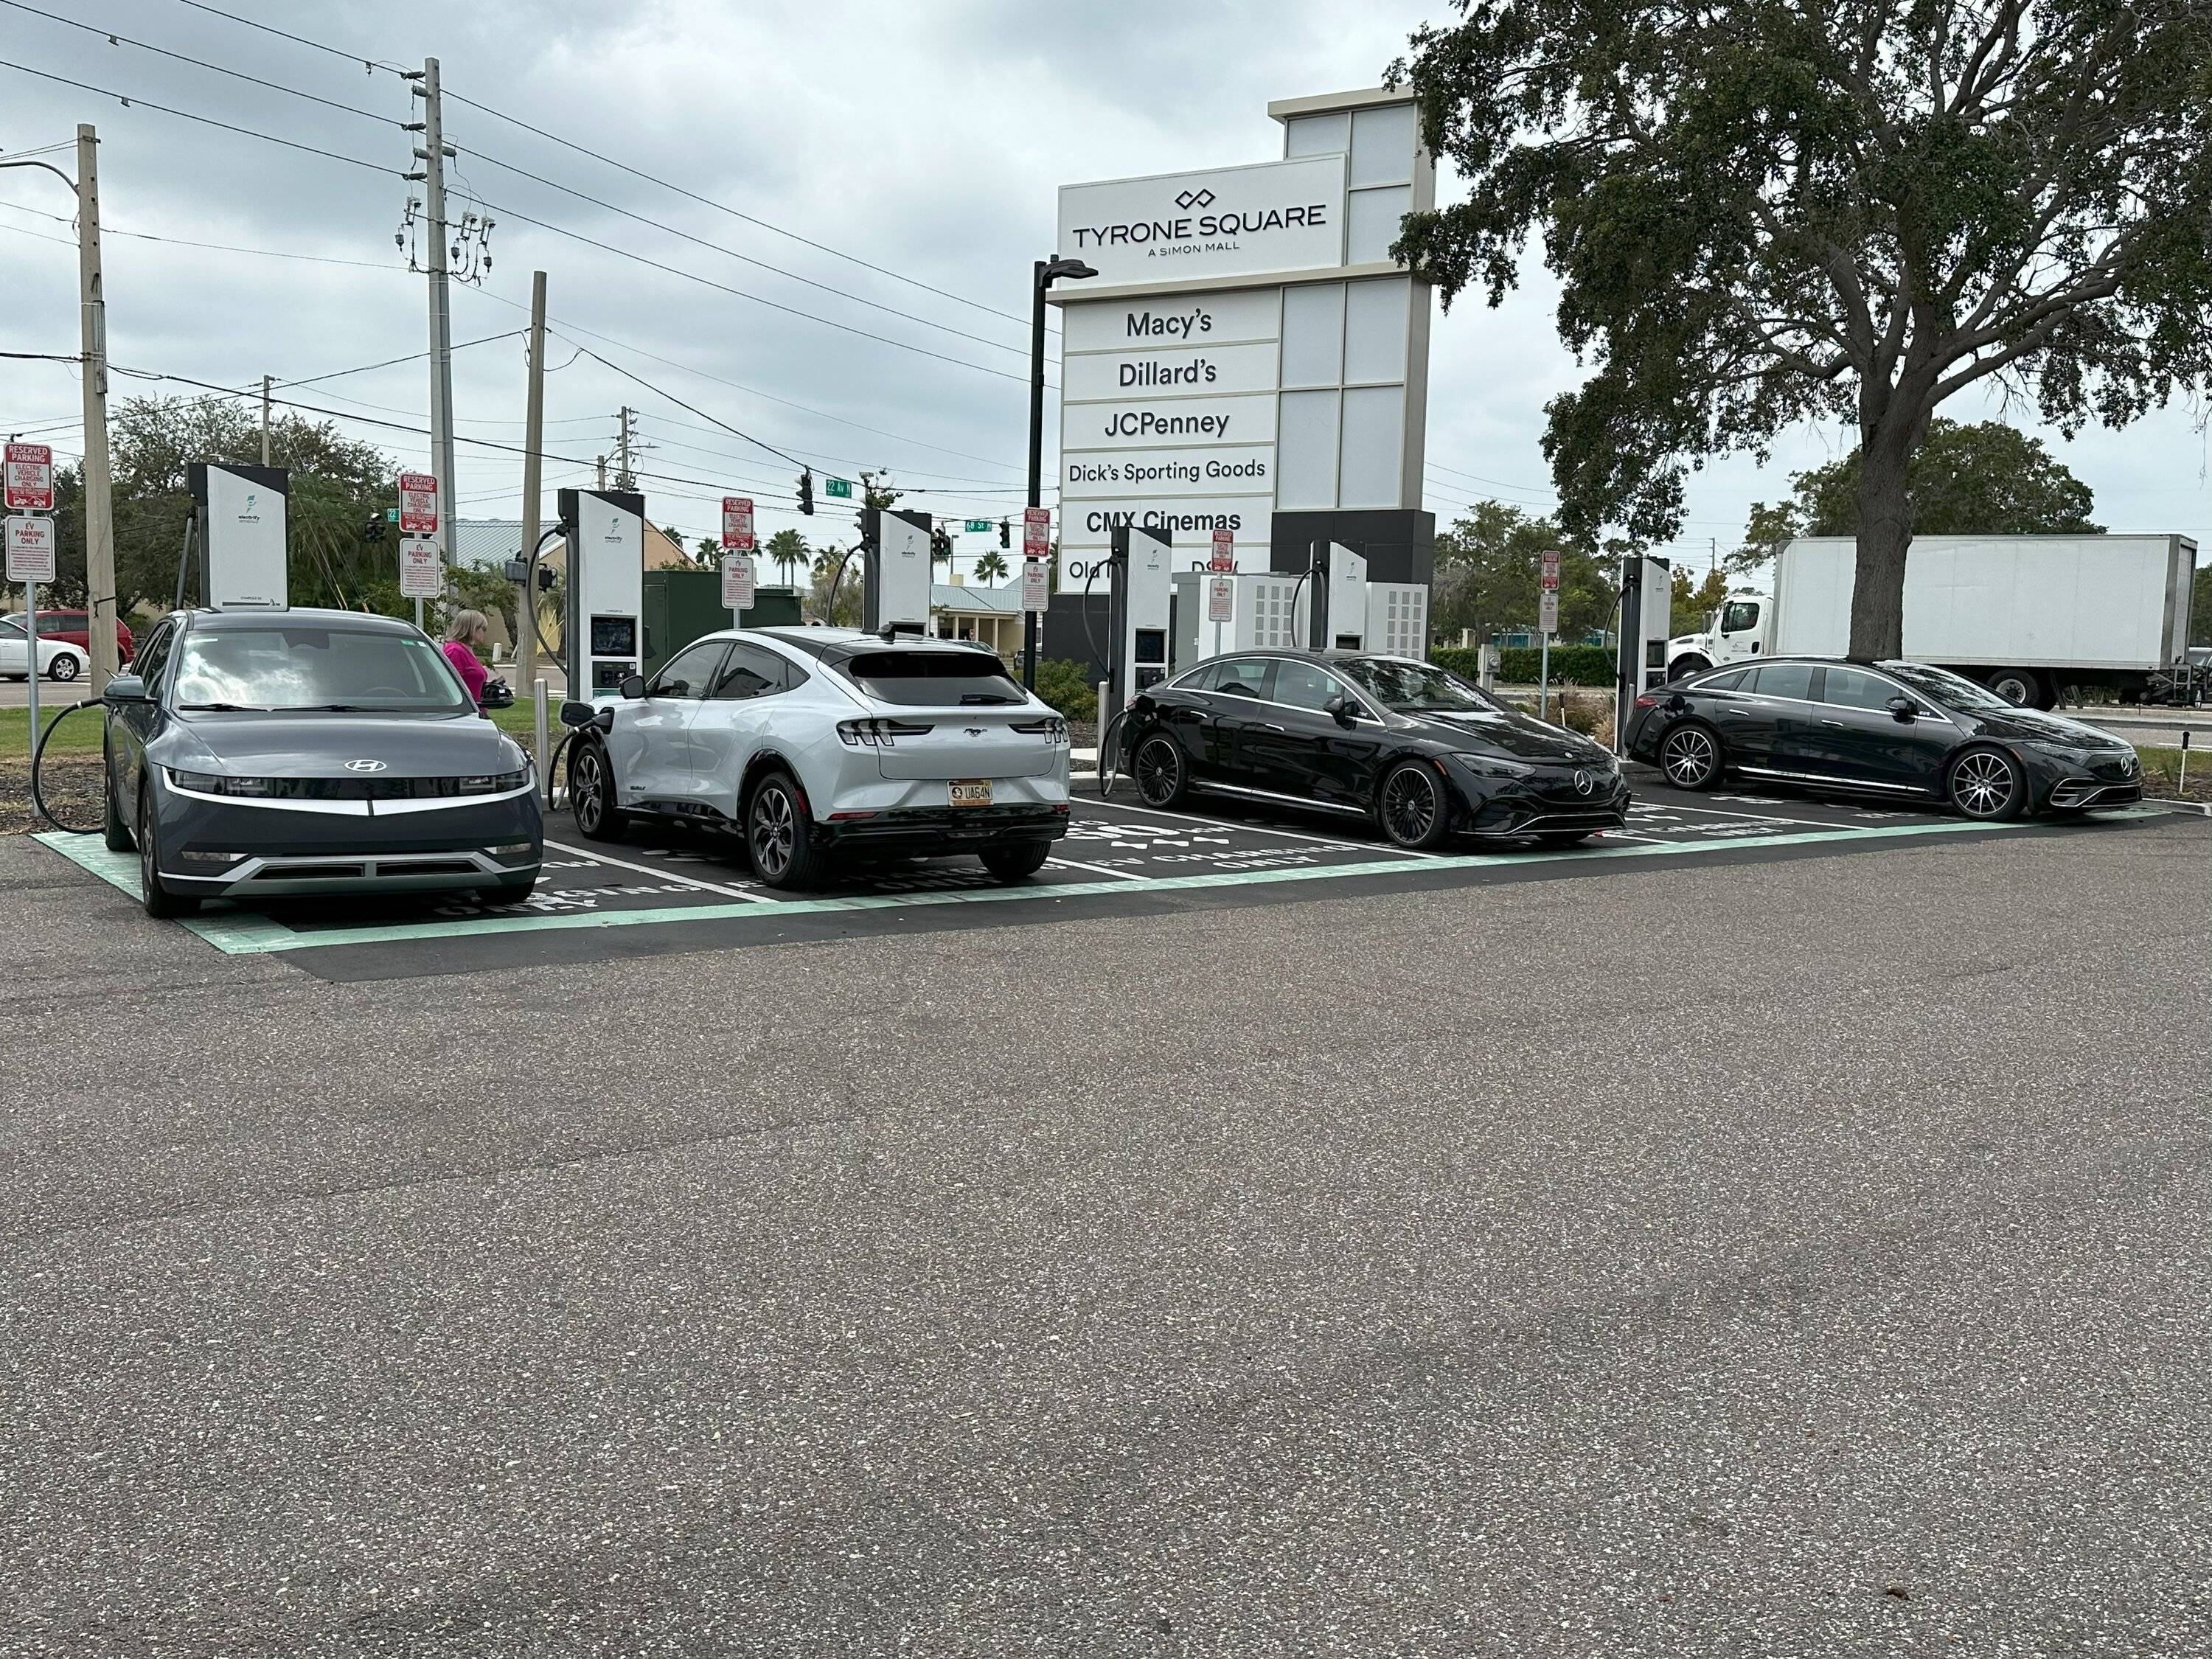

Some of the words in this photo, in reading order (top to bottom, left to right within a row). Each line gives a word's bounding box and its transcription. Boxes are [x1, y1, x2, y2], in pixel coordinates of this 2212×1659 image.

[1073, 218, 1192, 248] TYRONE
[1199, 204, 1326, 236] SQUARE
[1148, 248, 1156, 257] A
[1160, 244, 1201, 255] SIMON
[1206, 241, 1240, 251] MALL
[1127, 308, 1212, 339] Macy's
[1119, 358, 1217, 387] Dillard's
[1105, 411, 1231, 438] JCPenney
[9, 445, 48, 456] RESERVED
[12, 453, 46, 463] PARKING
[1069, 464, 1119, 482] Dick's
[1124, 462, 1200, 484] Sporting
[1206, 459, 1266, 478] Goods
[403, 476, 435, 485] RESERVED
[406, 482, 433, 492] PARKING
[827, 480, 835, 492] 22
[26, 522, 35, 530] EV
[967, 521, 974, 529] 68
[1086, 512, 1136, 532] CMX
[1143, 511, 1242, 531] Cinemas
[15, 529, 45, 538] PARKING
[21, 537, 39, 545] ONLY
[408, 550, 432, 559] PARKING
[1069, 561, 1100, 579] Old
[964, 786, 990, 799] UA64N
[1151, 844, 1360, 862] CHARGING
[1212, 855, 1320, 869] ONLY
